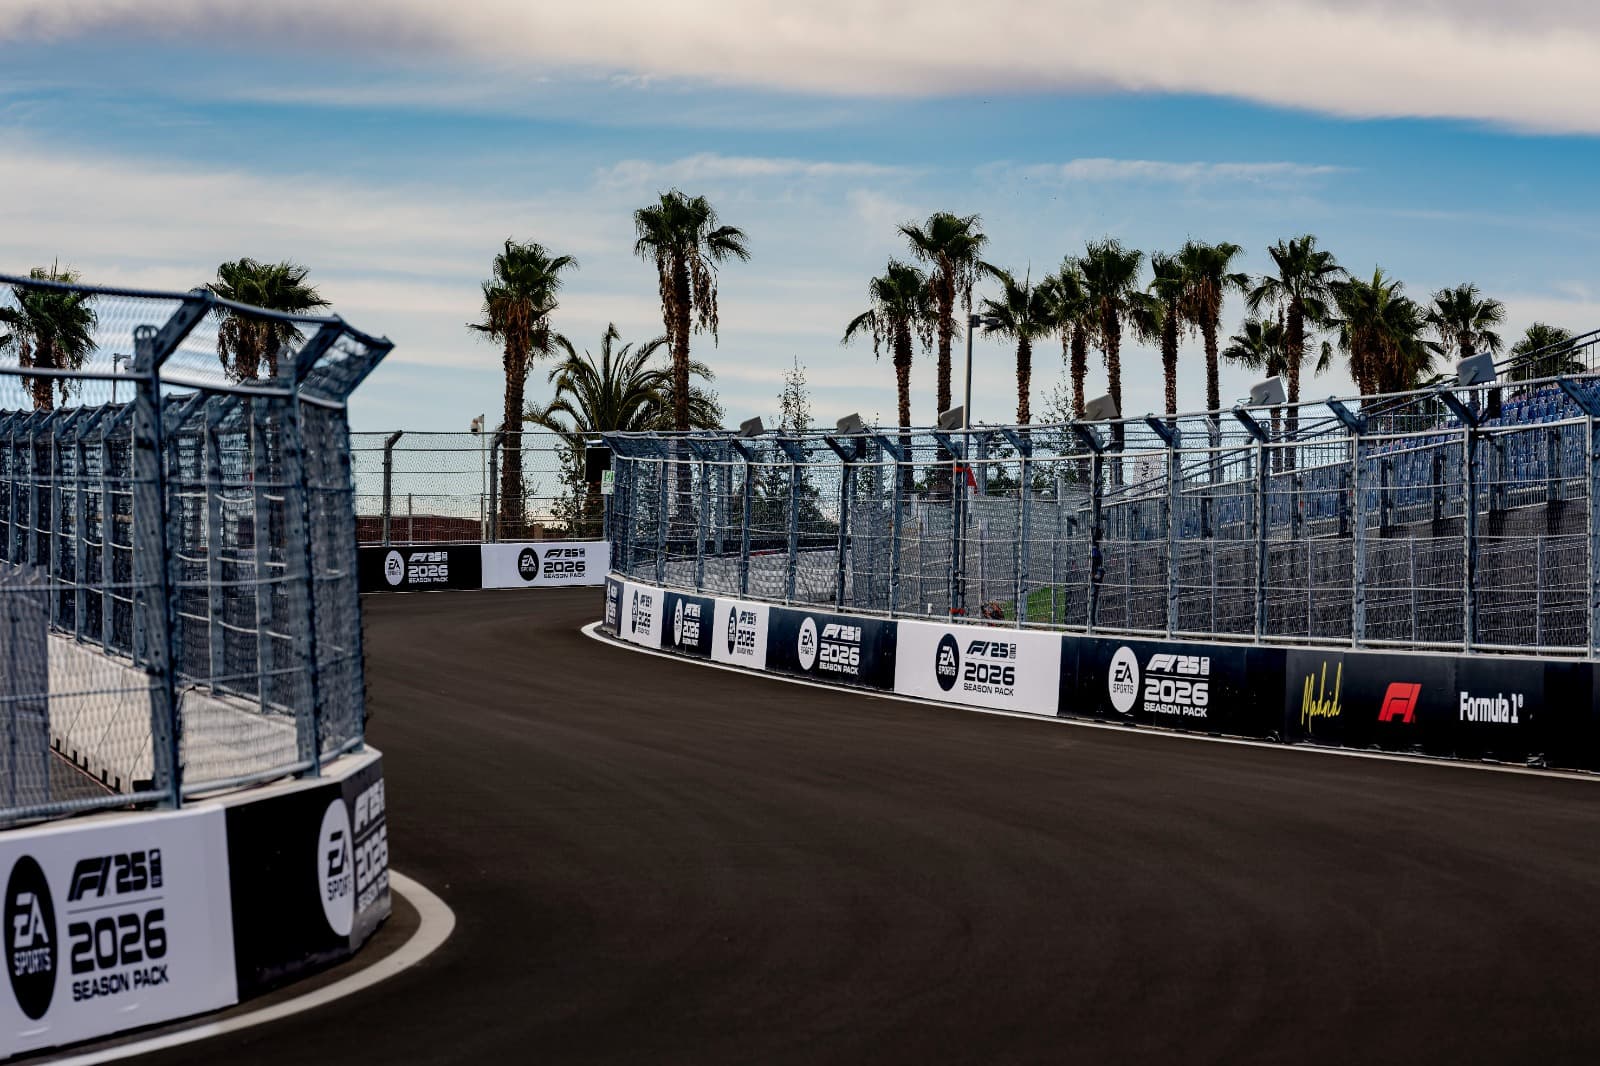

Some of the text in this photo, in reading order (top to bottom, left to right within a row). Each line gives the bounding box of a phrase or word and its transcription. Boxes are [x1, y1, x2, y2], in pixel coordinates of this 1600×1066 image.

[388, 559, 400, 569] EA
[522, 555, 535, 566] EA
[544, 561, 585, 573] 2026
[408, 565, 448, 577] 2026
[683, 621, 700, 638] 2026
[802, 629, 813, 646] EA
[841, 625, 854, 640] 25
[737, 630, 755, 647] 2026
[820, 643, 859, 665] 2026
[939, 646, 955, 666] EA
[991, 642, 1008, 658] 25
[843, 665, 859, 675] PACK
[1114, 662, 1133, 683] EA
[1177, 656, 1199, 674] 25
[964, 662, 1015, 686] 2026
[964, 683, 1014, 696] SEASON PACK
[1113, 684, 1134, 694] SPORTS
[1144, 678, 1208, 706] 2026
[1301, 661, 1342, 733] Madrid
[1144, 702, 1207, 717] SEASON PACK
[1460, 692, 1509, 723] Formula
[355, 826, 388, 893] 2026
[114, 852, 148, 894] 25
[14, 892, 49, 948] EA
[69, 908, 167, 975] 2026
[73, 965, 169, 1001] SEASON PACK
